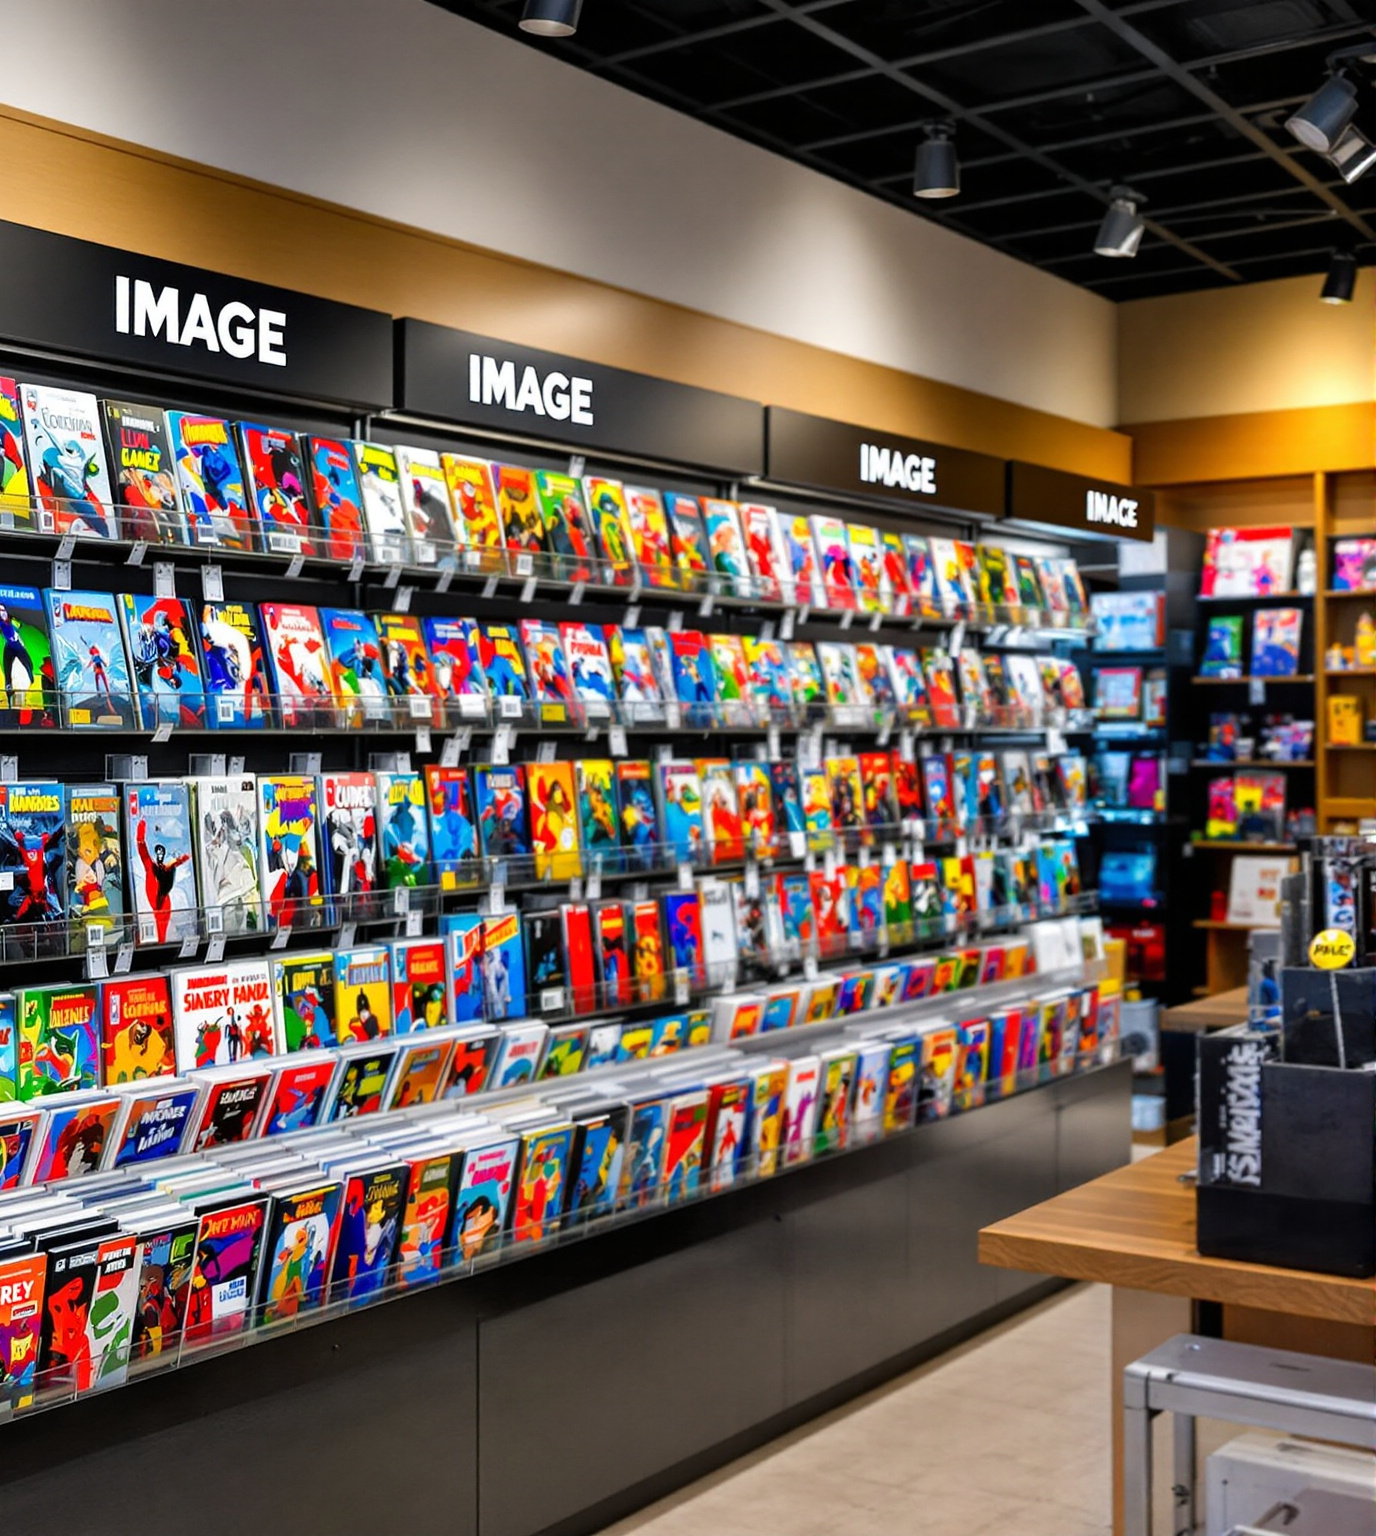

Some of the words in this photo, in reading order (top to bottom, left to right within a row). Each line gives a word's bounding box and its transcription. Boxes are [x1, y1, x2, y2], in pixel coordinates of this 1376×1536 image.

[115, 275, 287, 367] IMAGE
[468, 354, 594, 426] IMAGE
[860, 443, 937, 494] IMAGE
